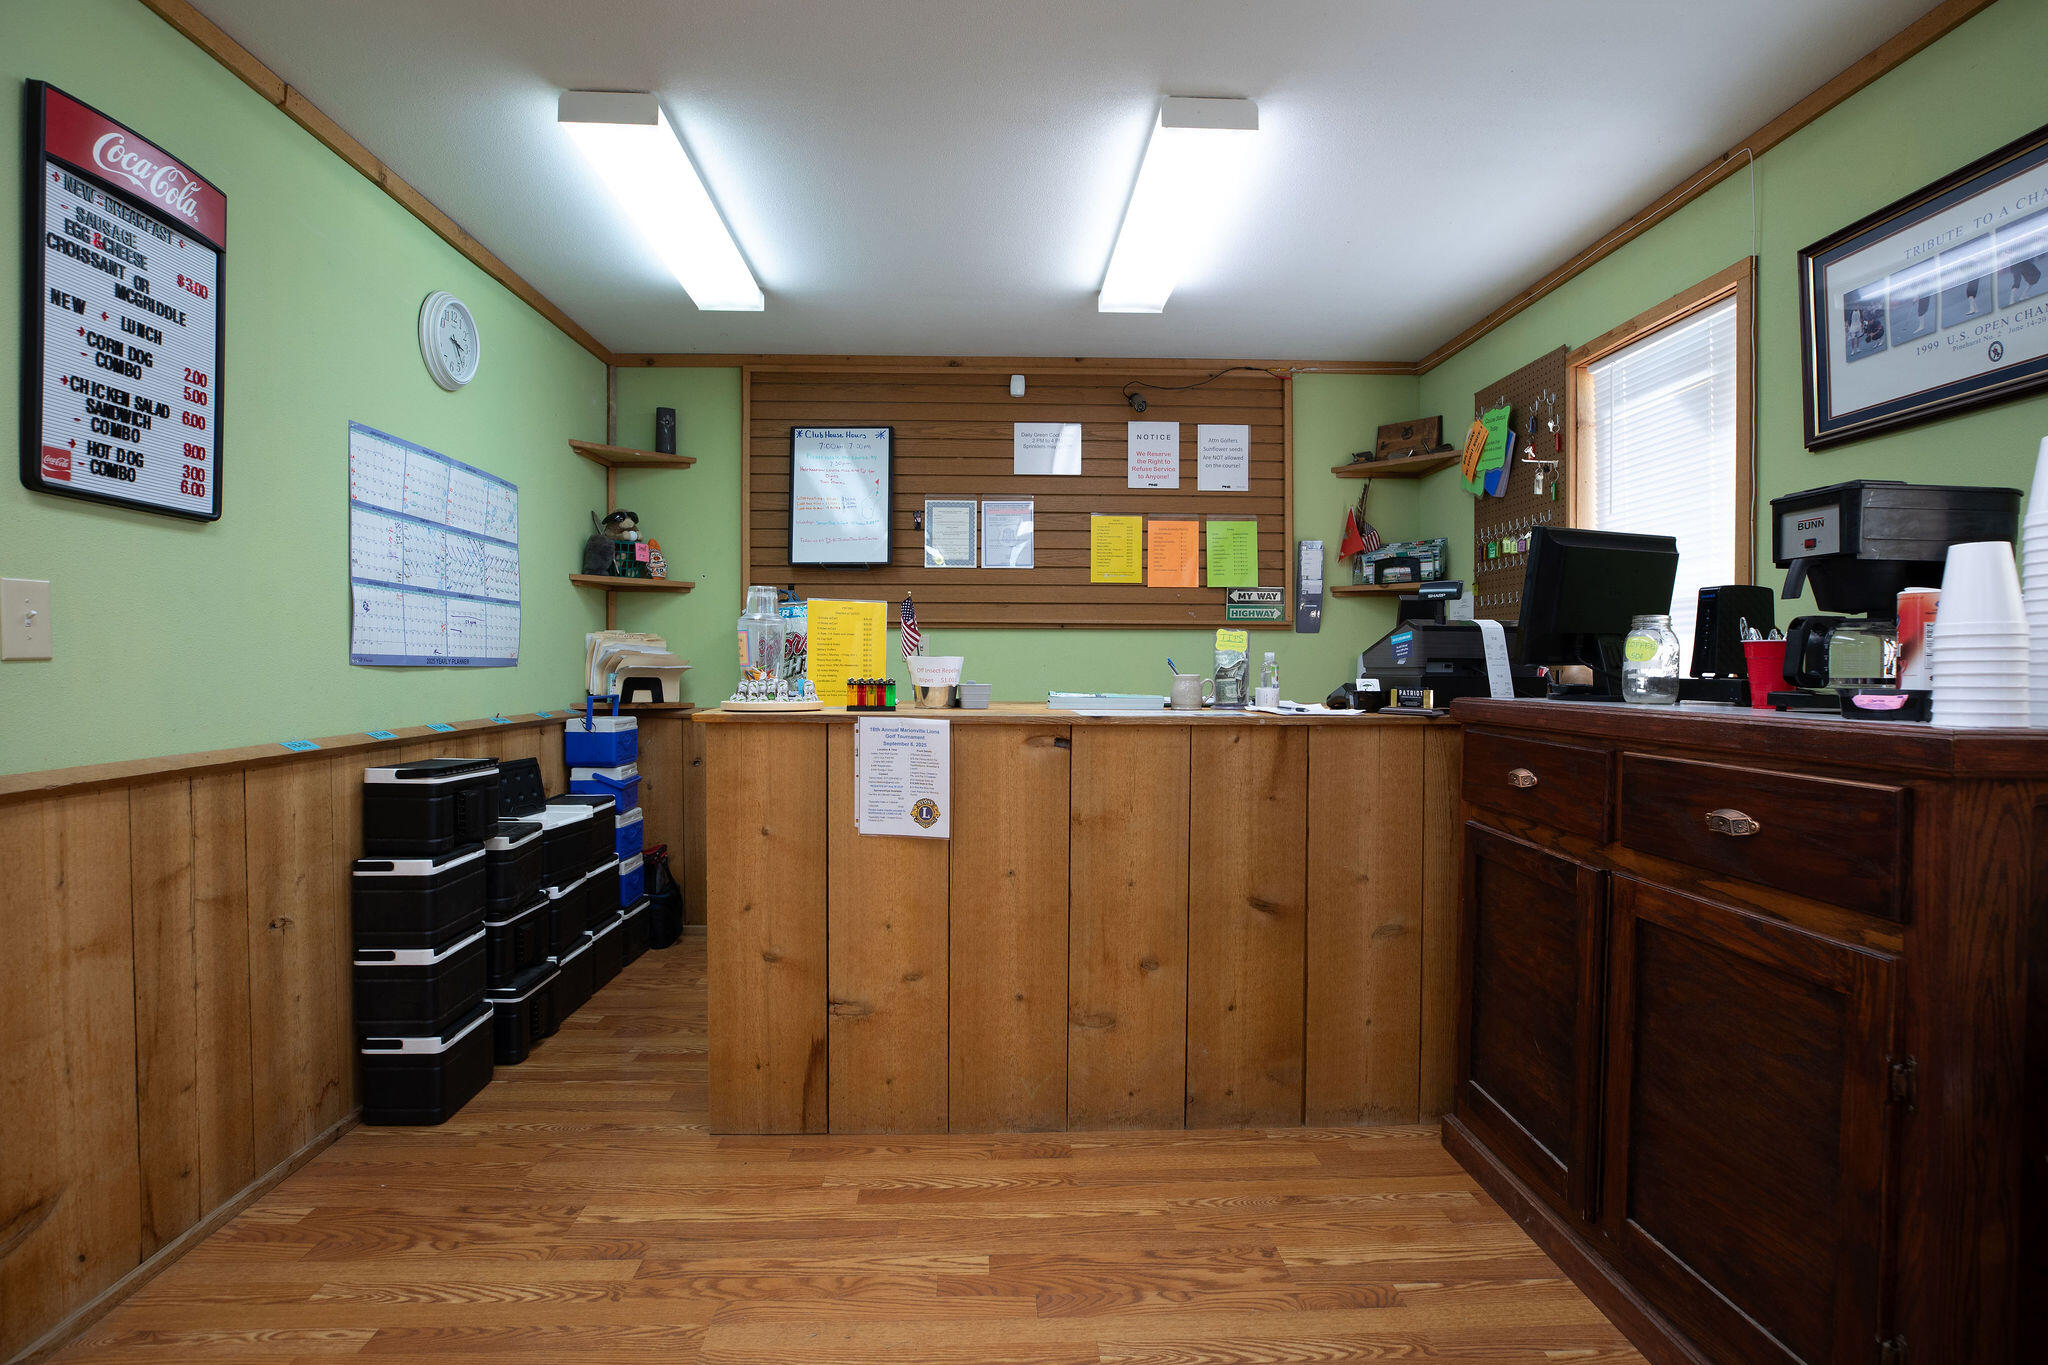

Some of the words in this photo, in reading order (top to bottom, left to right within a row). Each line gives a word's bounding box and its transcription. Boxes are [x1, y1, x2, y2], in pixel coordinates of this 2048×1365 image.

[92, 132, 202, 221] Coca-Cola
[63, 174, 95, 204] NEW
[104, 196, 175, 245] BREAKFAST
[64, 217, 91, 243] EGG
[75, 206, 137, 250] SAUSAGE
[1903, 225, 1963, 260] TRIBUTE
[1972, 212, 1993, 229] TO
[2000, 206, 2009, 218] A
[46, 231, 127, 280] CROISSANT
[133, 274, 150, 295] OR
[176, 273, 209, 300] $3.00
[50, 287, 87, 315] NEW
[120, 315, 163, 346] LUNCH
[114, 283, 187, 327] MCGRIDDLE
[451, 310, 458, 324] 12
[1916, 340, 1939, 356] 1999
[1946, 331, 1970, 345] U.S.
[1974, 316, 2009, 336] OPEN
[2014, 303, 2048, 323] CHA
[2008, 325, 2024, 334] June
[86, 330, 124, 357] CORN
[128, 346, 153, 368] DOG
[95, 352, 142, 380] COMBO
[183, 367, 208, 387] 2.00
[69, 375, 131, 410] CHICKEN
[134, 396, 170, 419] SALAD
[183, 386, 208, 406] 5.00
[85, 397, 152, 430] SANDWICH
[182, 410, 206, 431] 6.00
[90, 416, 141, 444] COMBO
[804, 430, 824, 439] Club
[825, 430, 844, 439] House
[845, 430, 867, 440] Hours
[86, 440, 112, 460] HOT
[116, 448, 144, 468] DOG
[89, 459, 136, 482] COMBO
[180, 480, 206, 498] 6.00
[1797, 519, 1825, 531] BUNN
[1237, 592, 1253, 600] MY
[1257, 592, 1279, 600] WAY
[1231, 609, 1276, 617] HIGHWAY
[1220, 633, 1244, 643] TIPS
[1398, 689, 1424, 697] PATRIOT
[921, 807, 931, 820] L
